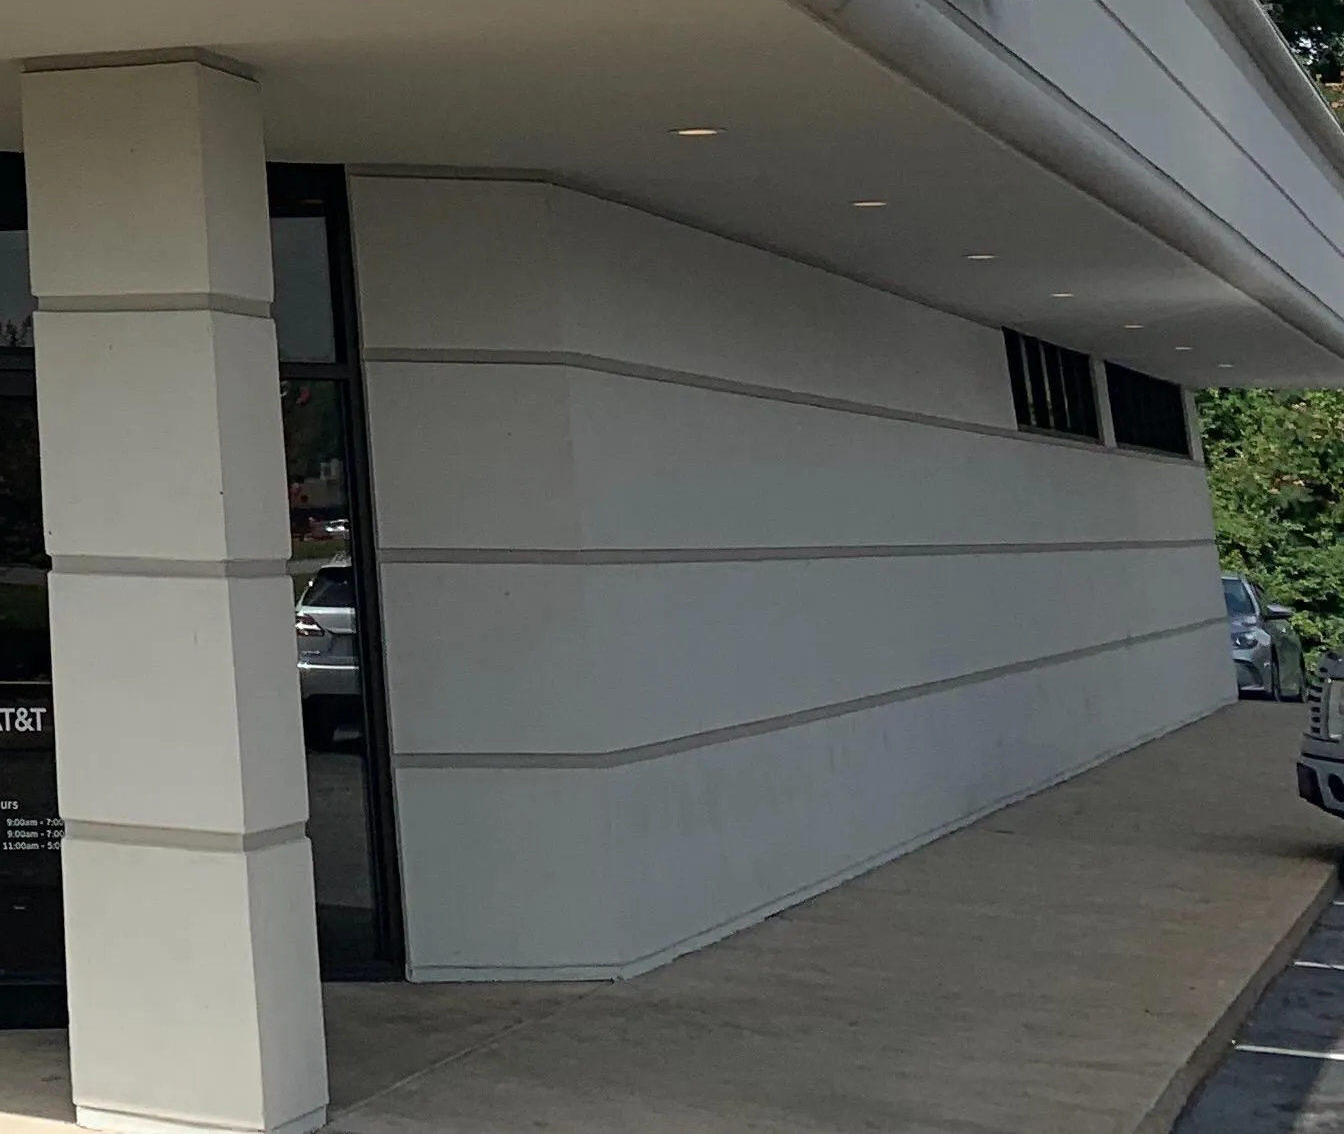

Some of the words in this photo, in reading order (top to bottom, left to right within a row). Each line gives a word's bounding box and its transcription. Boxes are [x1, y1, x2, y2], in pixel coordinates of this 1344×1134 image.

[6, 818, 38, 826] 9:00am
[6, 830, 39, 838] 9:00am
[2, 842, 39, 850] 11:00am
